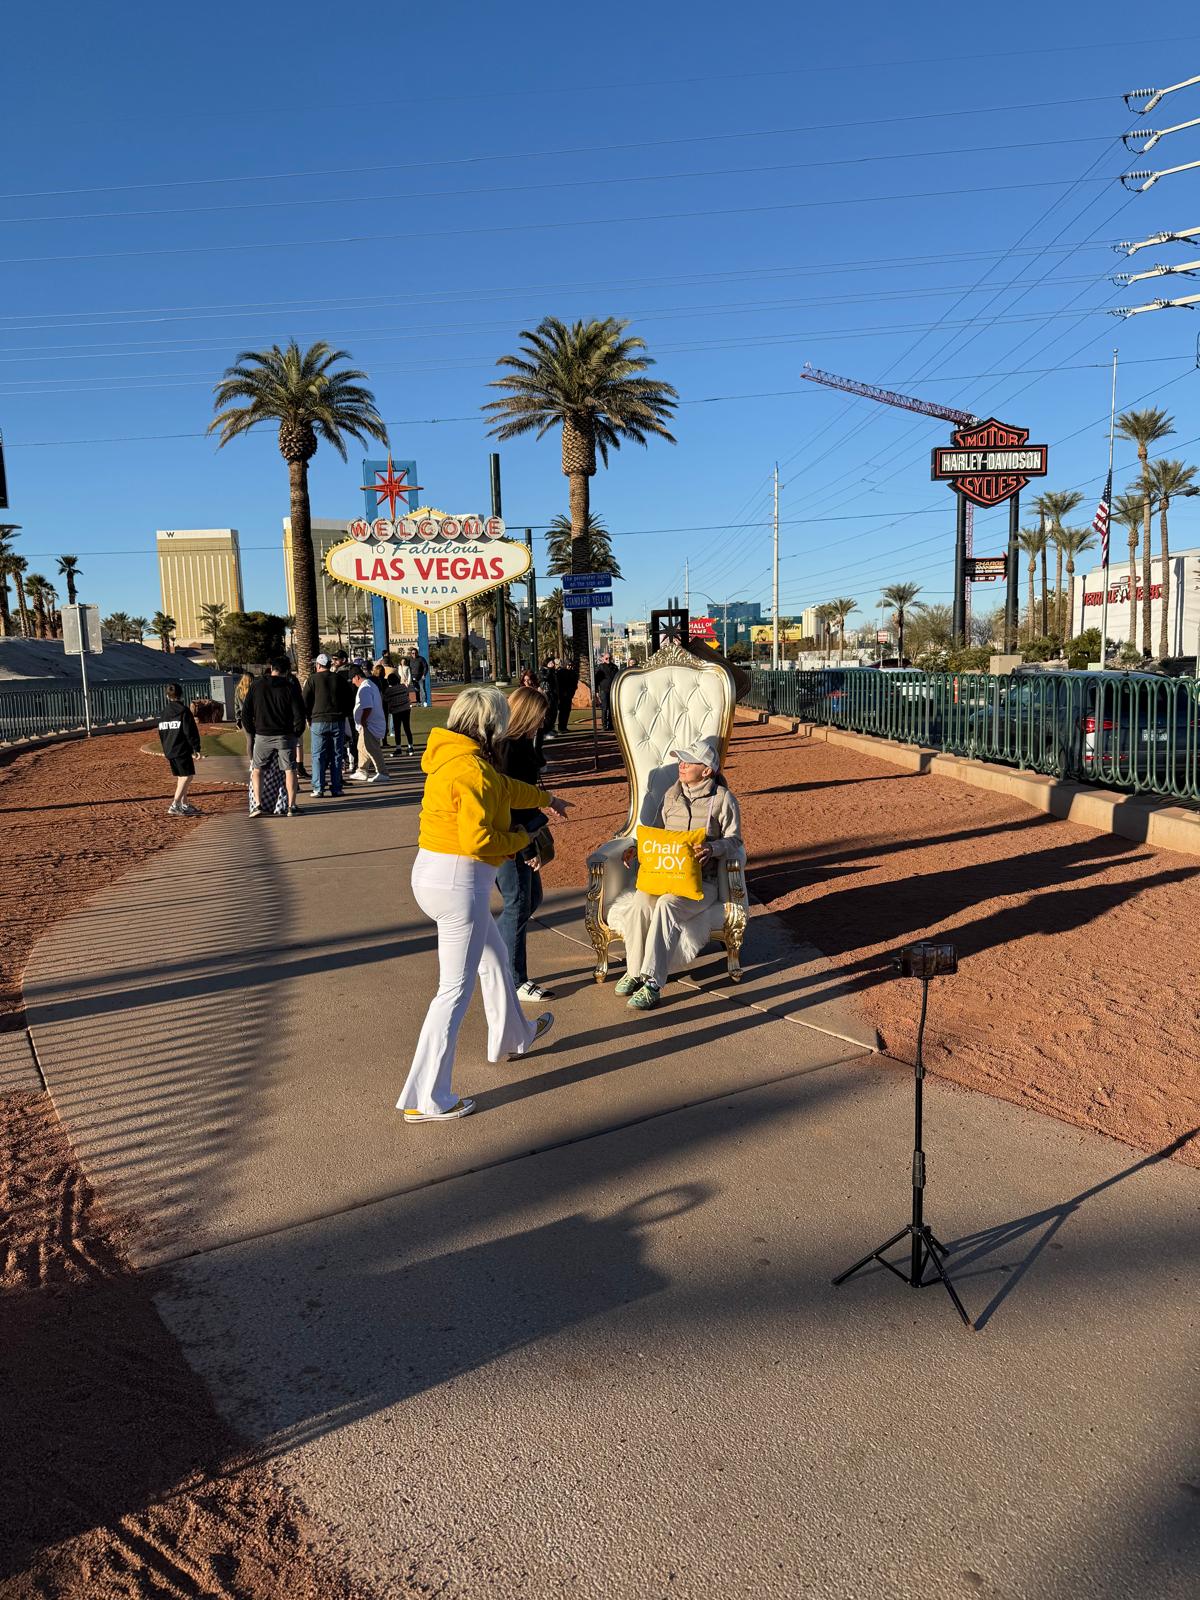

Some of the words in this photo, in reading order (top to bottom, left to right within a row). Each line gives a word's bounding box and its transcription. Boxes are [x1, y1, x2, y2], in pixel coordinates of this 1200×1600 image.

[965, 426, 1018, 447] MOTOR
[941, 451, 1041, 471] HARLEY-DAVIDSON
[964, 476, 1017, 499] CYCLES
[351, 517, 501, 538] WELCOME
[391, 541, 484, 556] Fabulous
[355, 558, 405, 581] LAS
[413, 557, 505, 581] VEGAS
[401, 586, 458, 595] NEVADA
[565, 596, 591, 607] STANDARD
[642, 840, 683, 855] Chair
[654, 855, 686, 870] JOY
